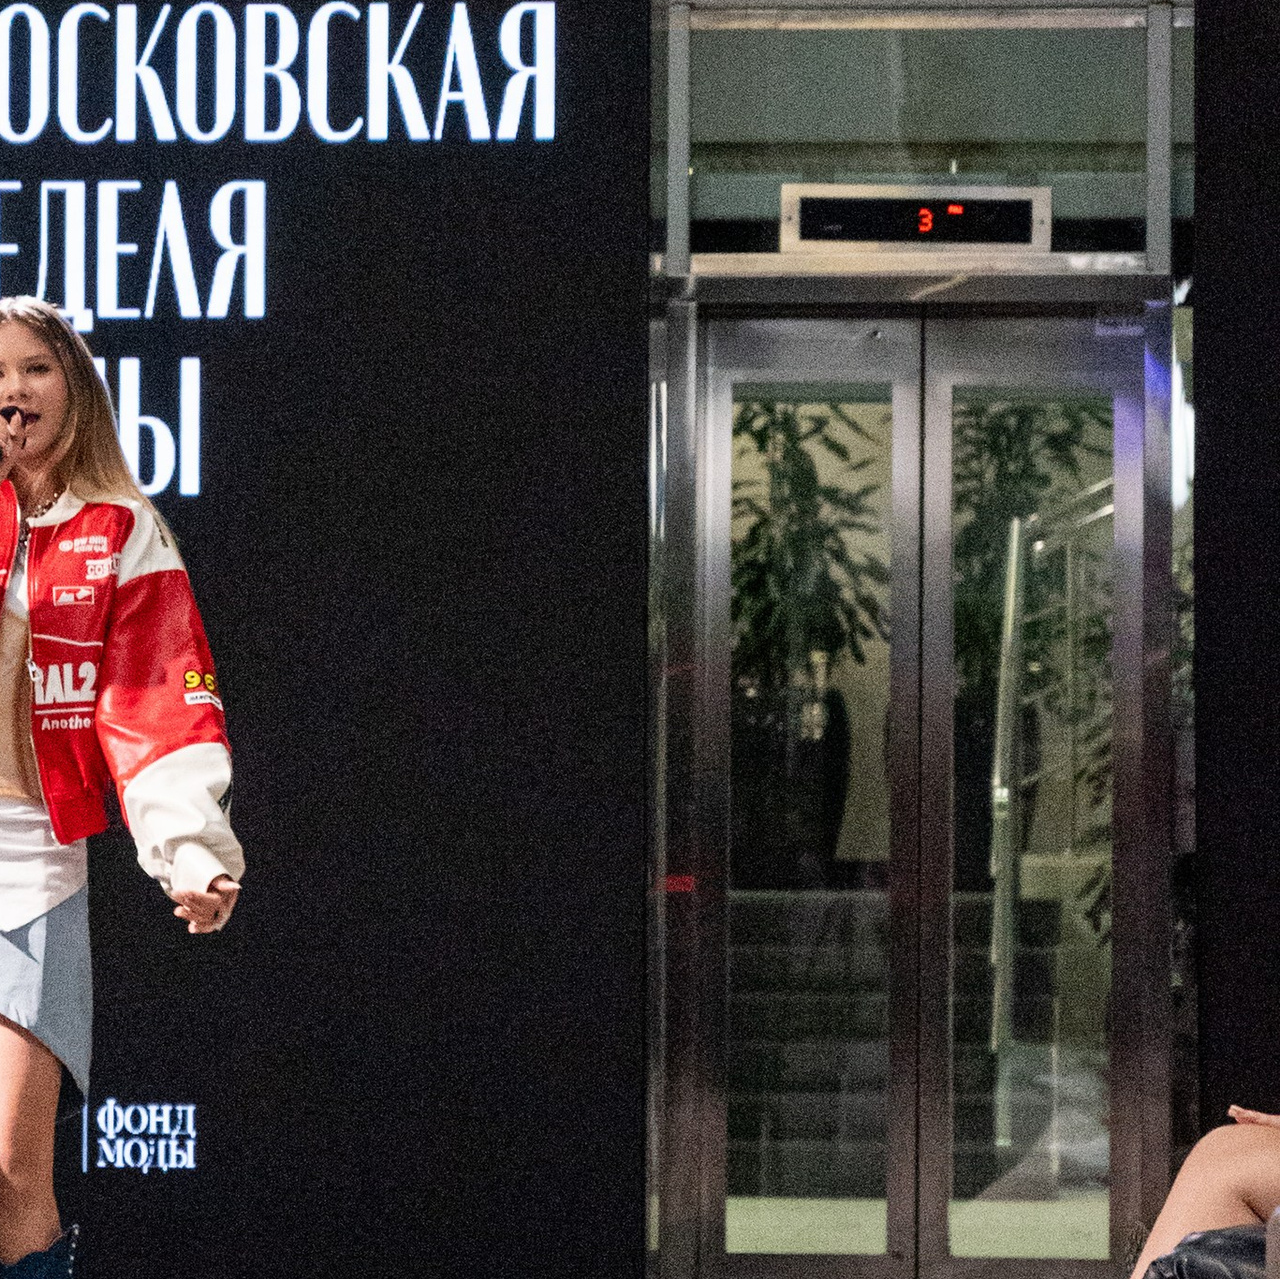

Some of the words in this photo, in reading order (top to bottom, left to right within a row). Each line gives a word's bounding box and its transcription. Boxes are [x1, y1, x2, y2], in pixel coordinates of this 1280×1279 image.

[918, 207, 934, 233] 3
[96, 1098, 196, 1139] ФОНД
[96, 1137, 197, 1174] МОДЫ
